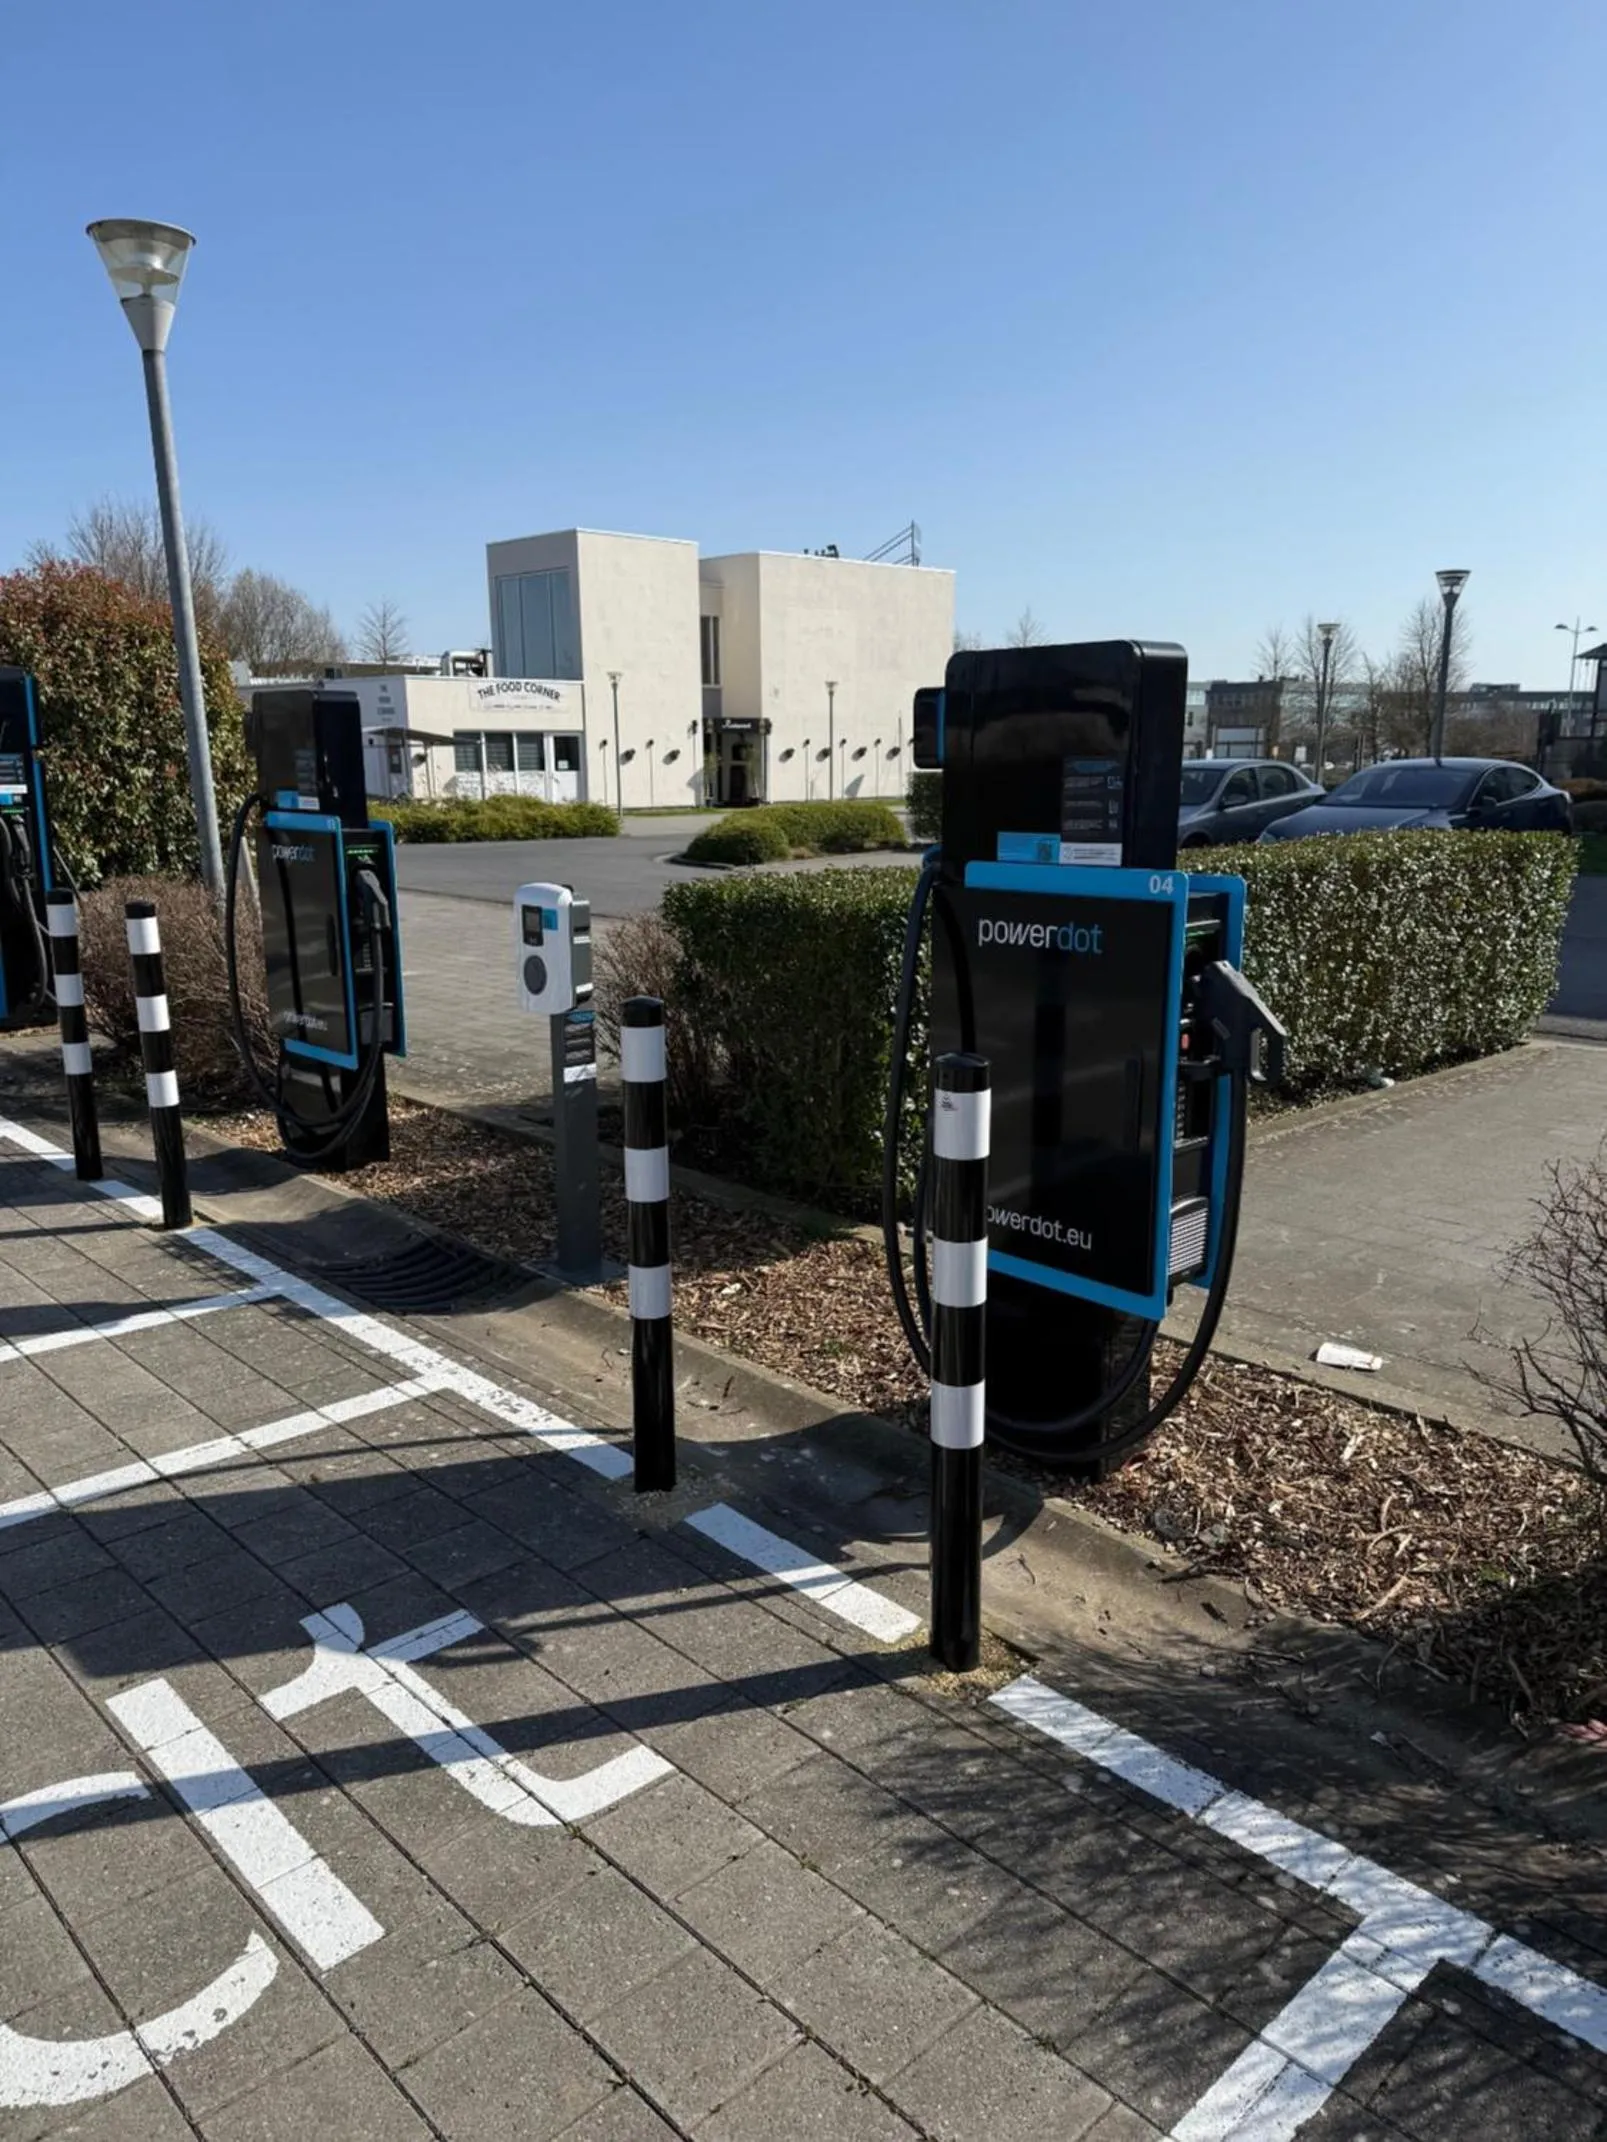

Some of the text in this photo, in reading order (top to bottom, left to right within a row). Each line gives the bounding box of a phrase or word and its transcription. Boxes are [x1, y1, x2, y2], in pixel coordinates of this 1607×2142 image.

[478, 681, 561, 703] THE FOOD CORNER
[1148, 874, 1175, 896] 04
[977, 918, 1104, 954] powerdot
[986, 1204, 1093, 1251] owerdot.eu
